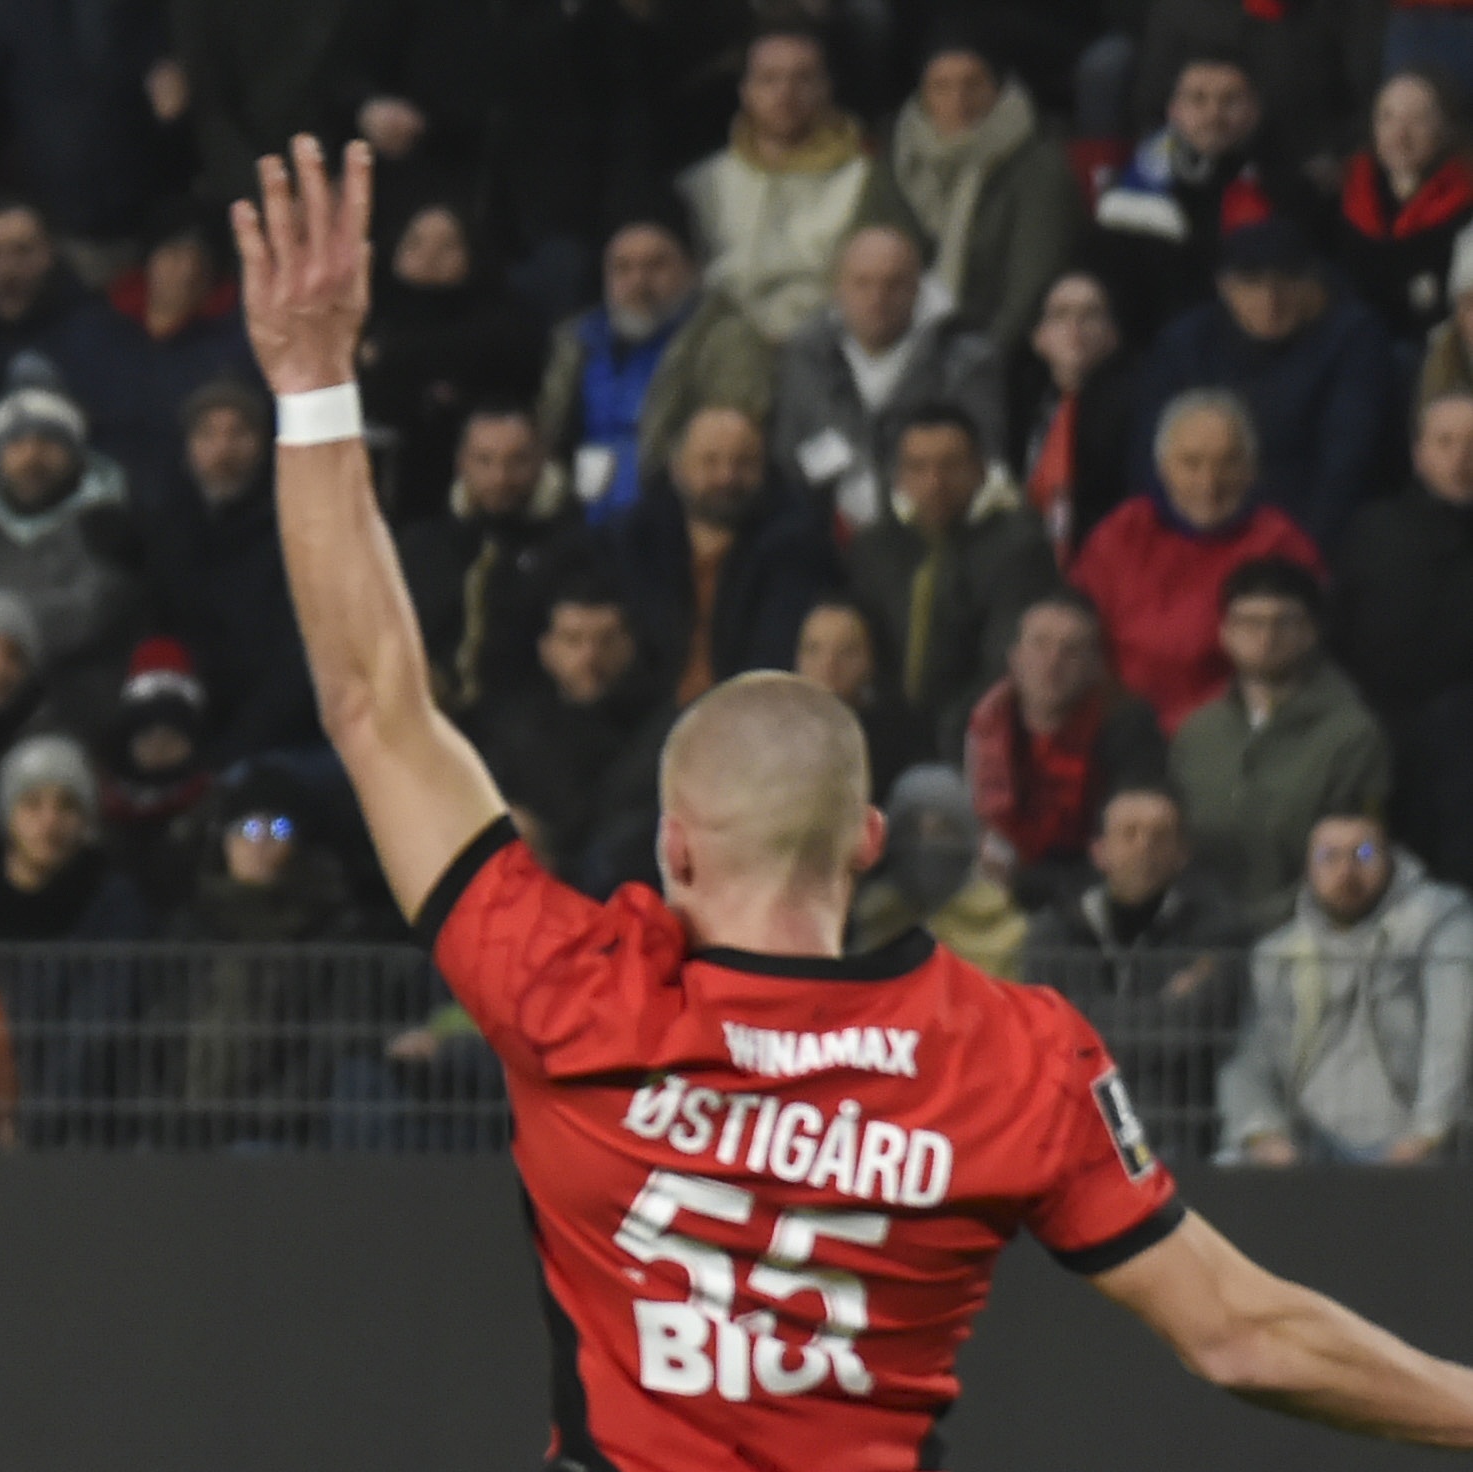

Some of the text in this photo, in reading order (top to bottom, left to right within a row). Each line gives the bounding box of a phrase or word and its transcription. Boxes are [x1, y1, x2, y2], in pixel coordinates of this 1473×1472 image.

[721, 1020, 920, 1079] WINAMAX
[622, 1074, 953, 1208] ØSTIGÅRD
[613, 1169, 890, 1342] 55
